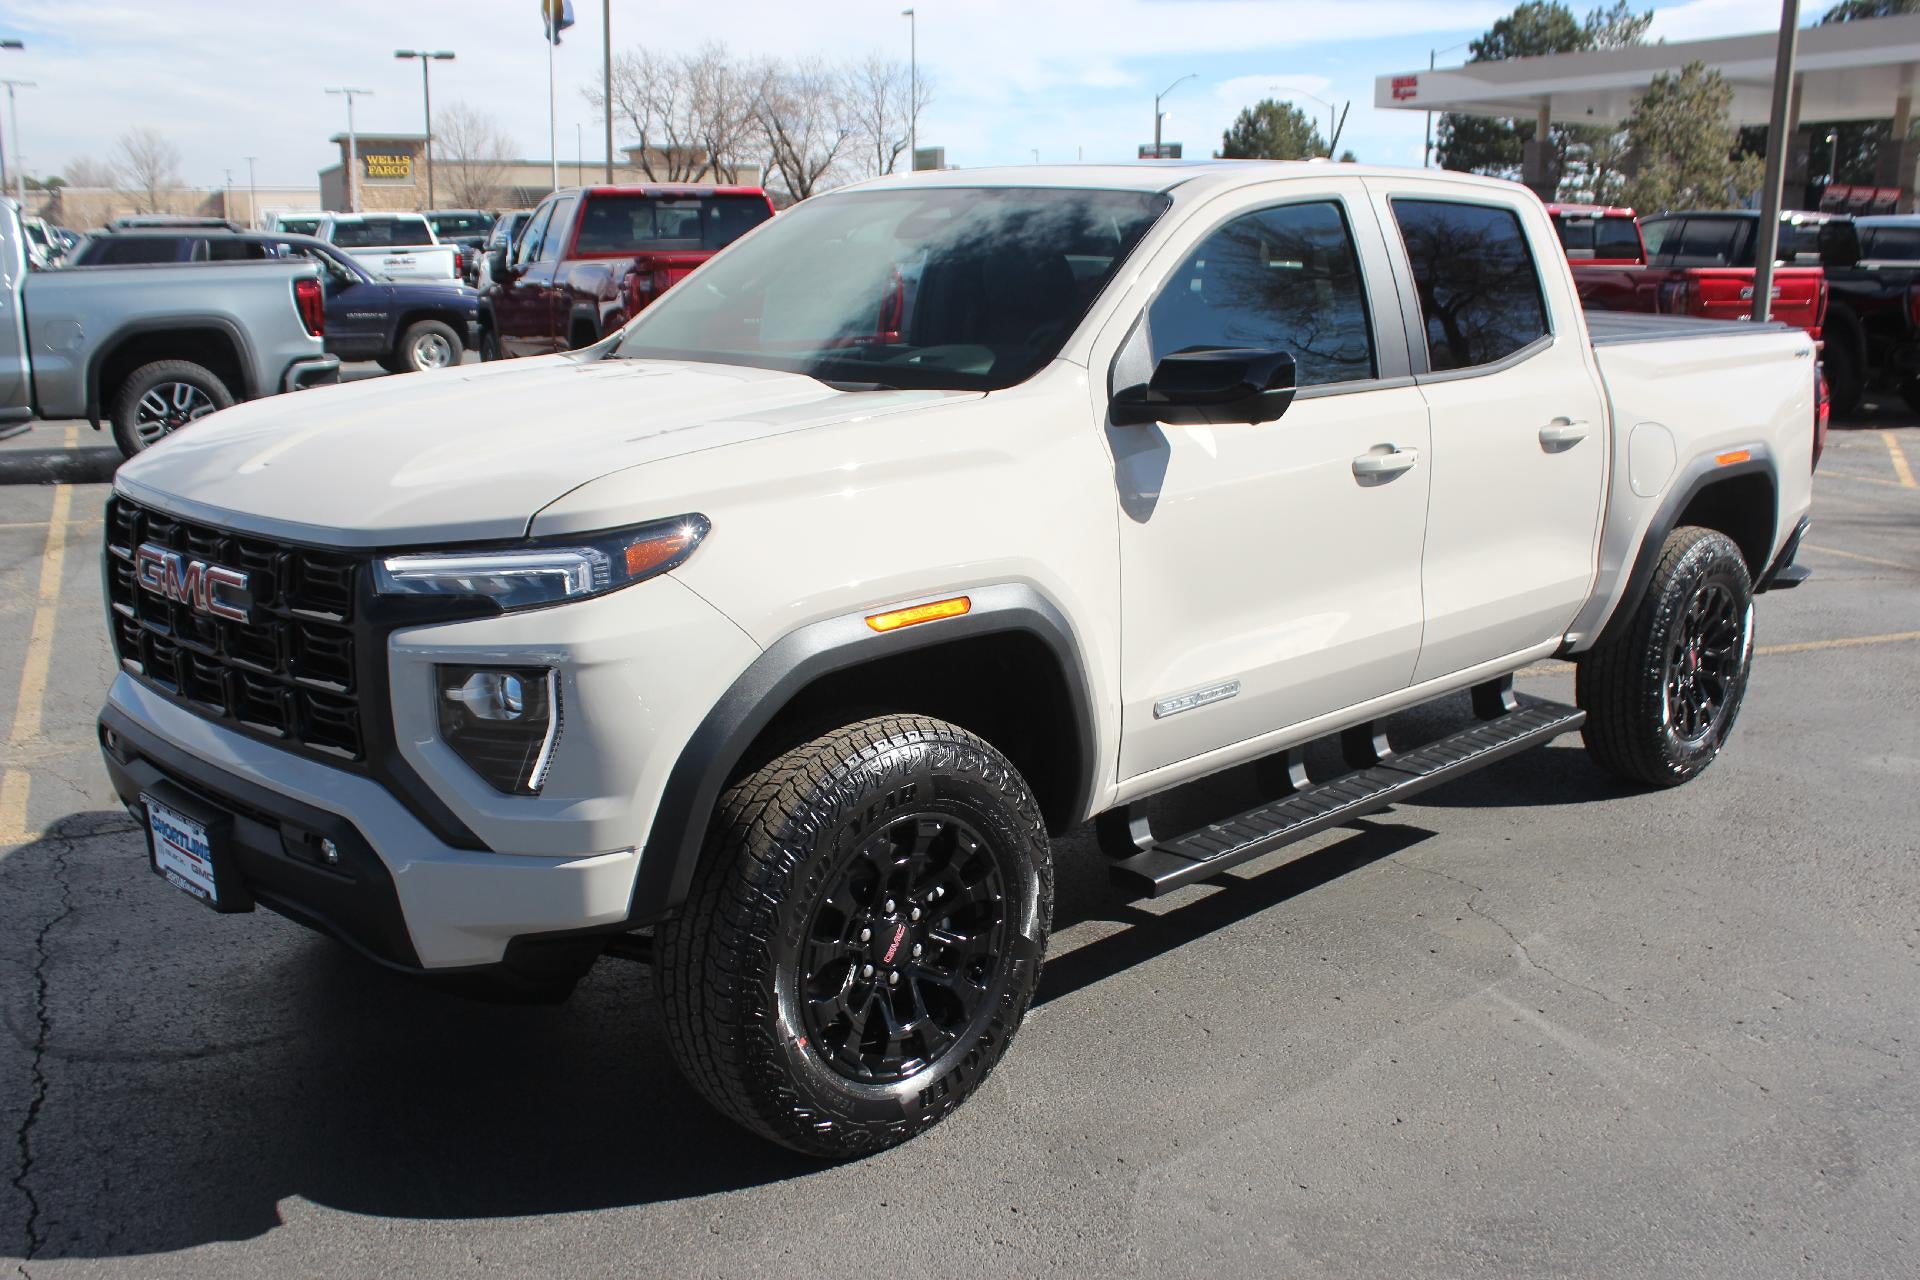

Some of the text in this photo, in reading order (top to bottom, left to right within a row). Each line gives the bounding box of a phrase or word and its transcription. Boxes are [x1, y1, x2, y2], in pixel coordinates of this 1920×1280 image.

[366, 155, 410, 164] WELLS
[368, 165, 410, 176] FARGO
[135, 543, 250, 624] GMC
[151, 814, 212, 863] SHORTLINE
[191, 863, 215, 883] GMC
[883, 923, 905, 963] GMC
